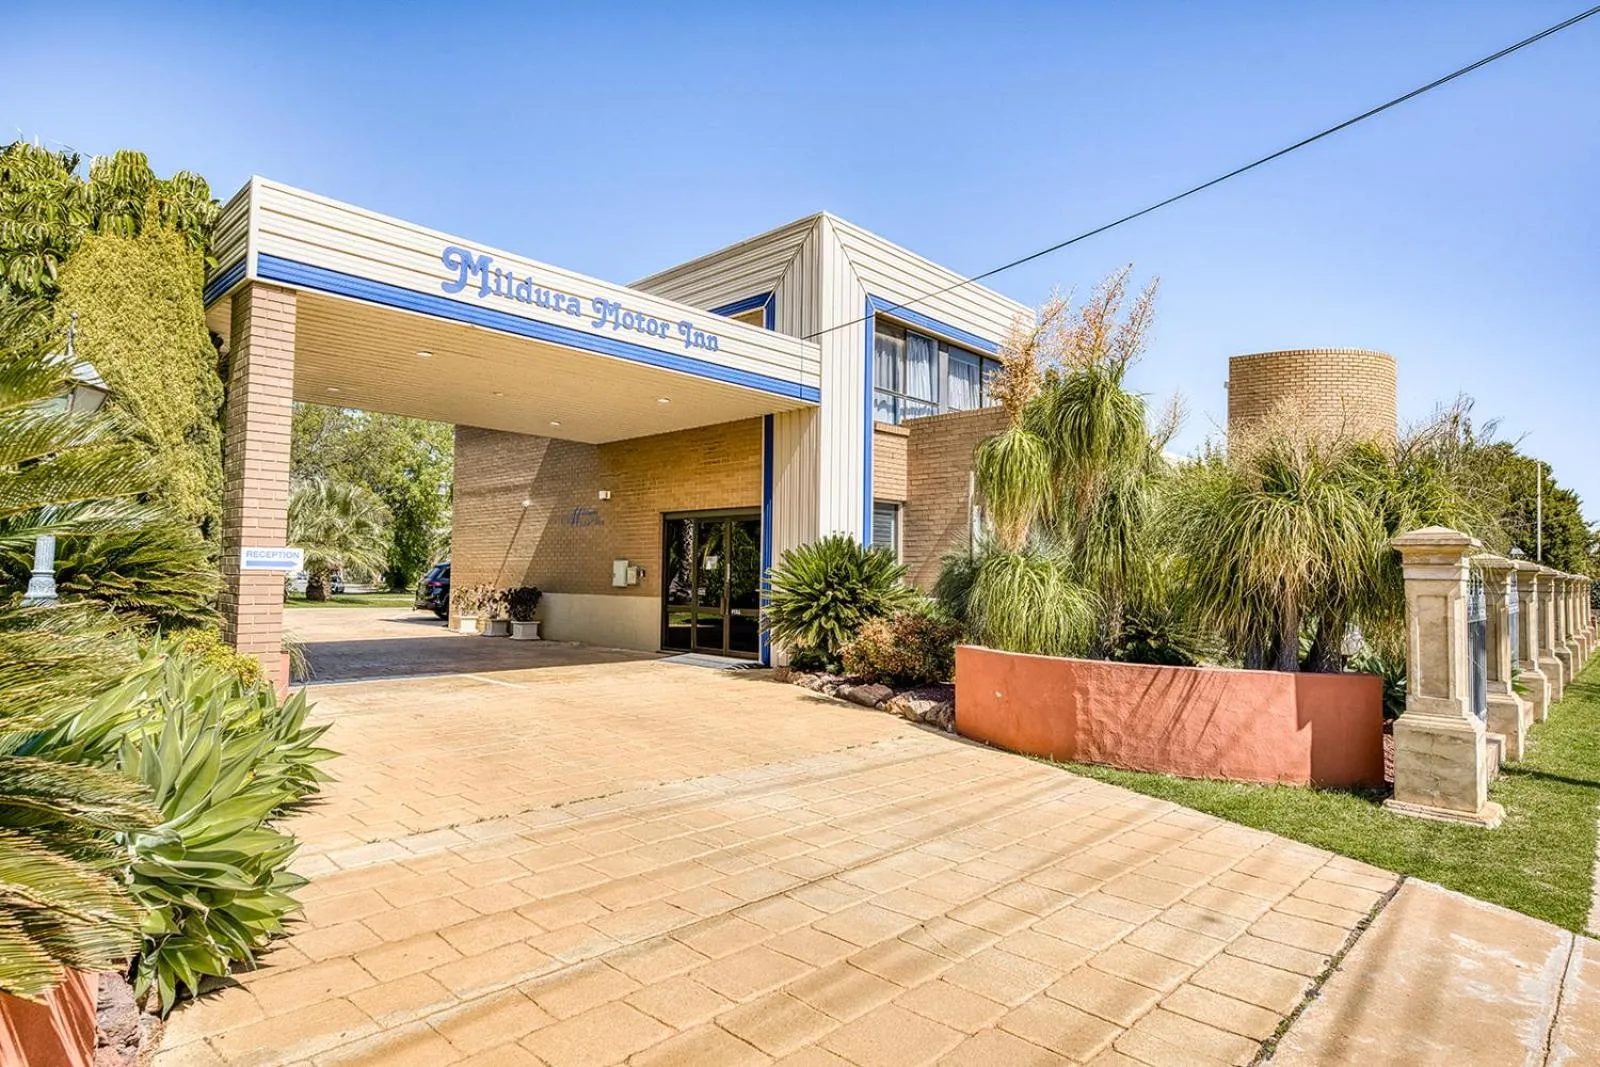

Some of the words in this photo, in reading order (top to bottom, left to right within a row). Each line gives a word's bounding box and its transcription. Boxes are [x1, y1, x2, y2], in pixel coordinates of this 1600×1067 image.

[441, 246, 582, 317] Mildura
[591, 297, 671, 339] Motor
[677, 320, 720, 352] Inn
[245, 550, 300, 558] RECEPTION
